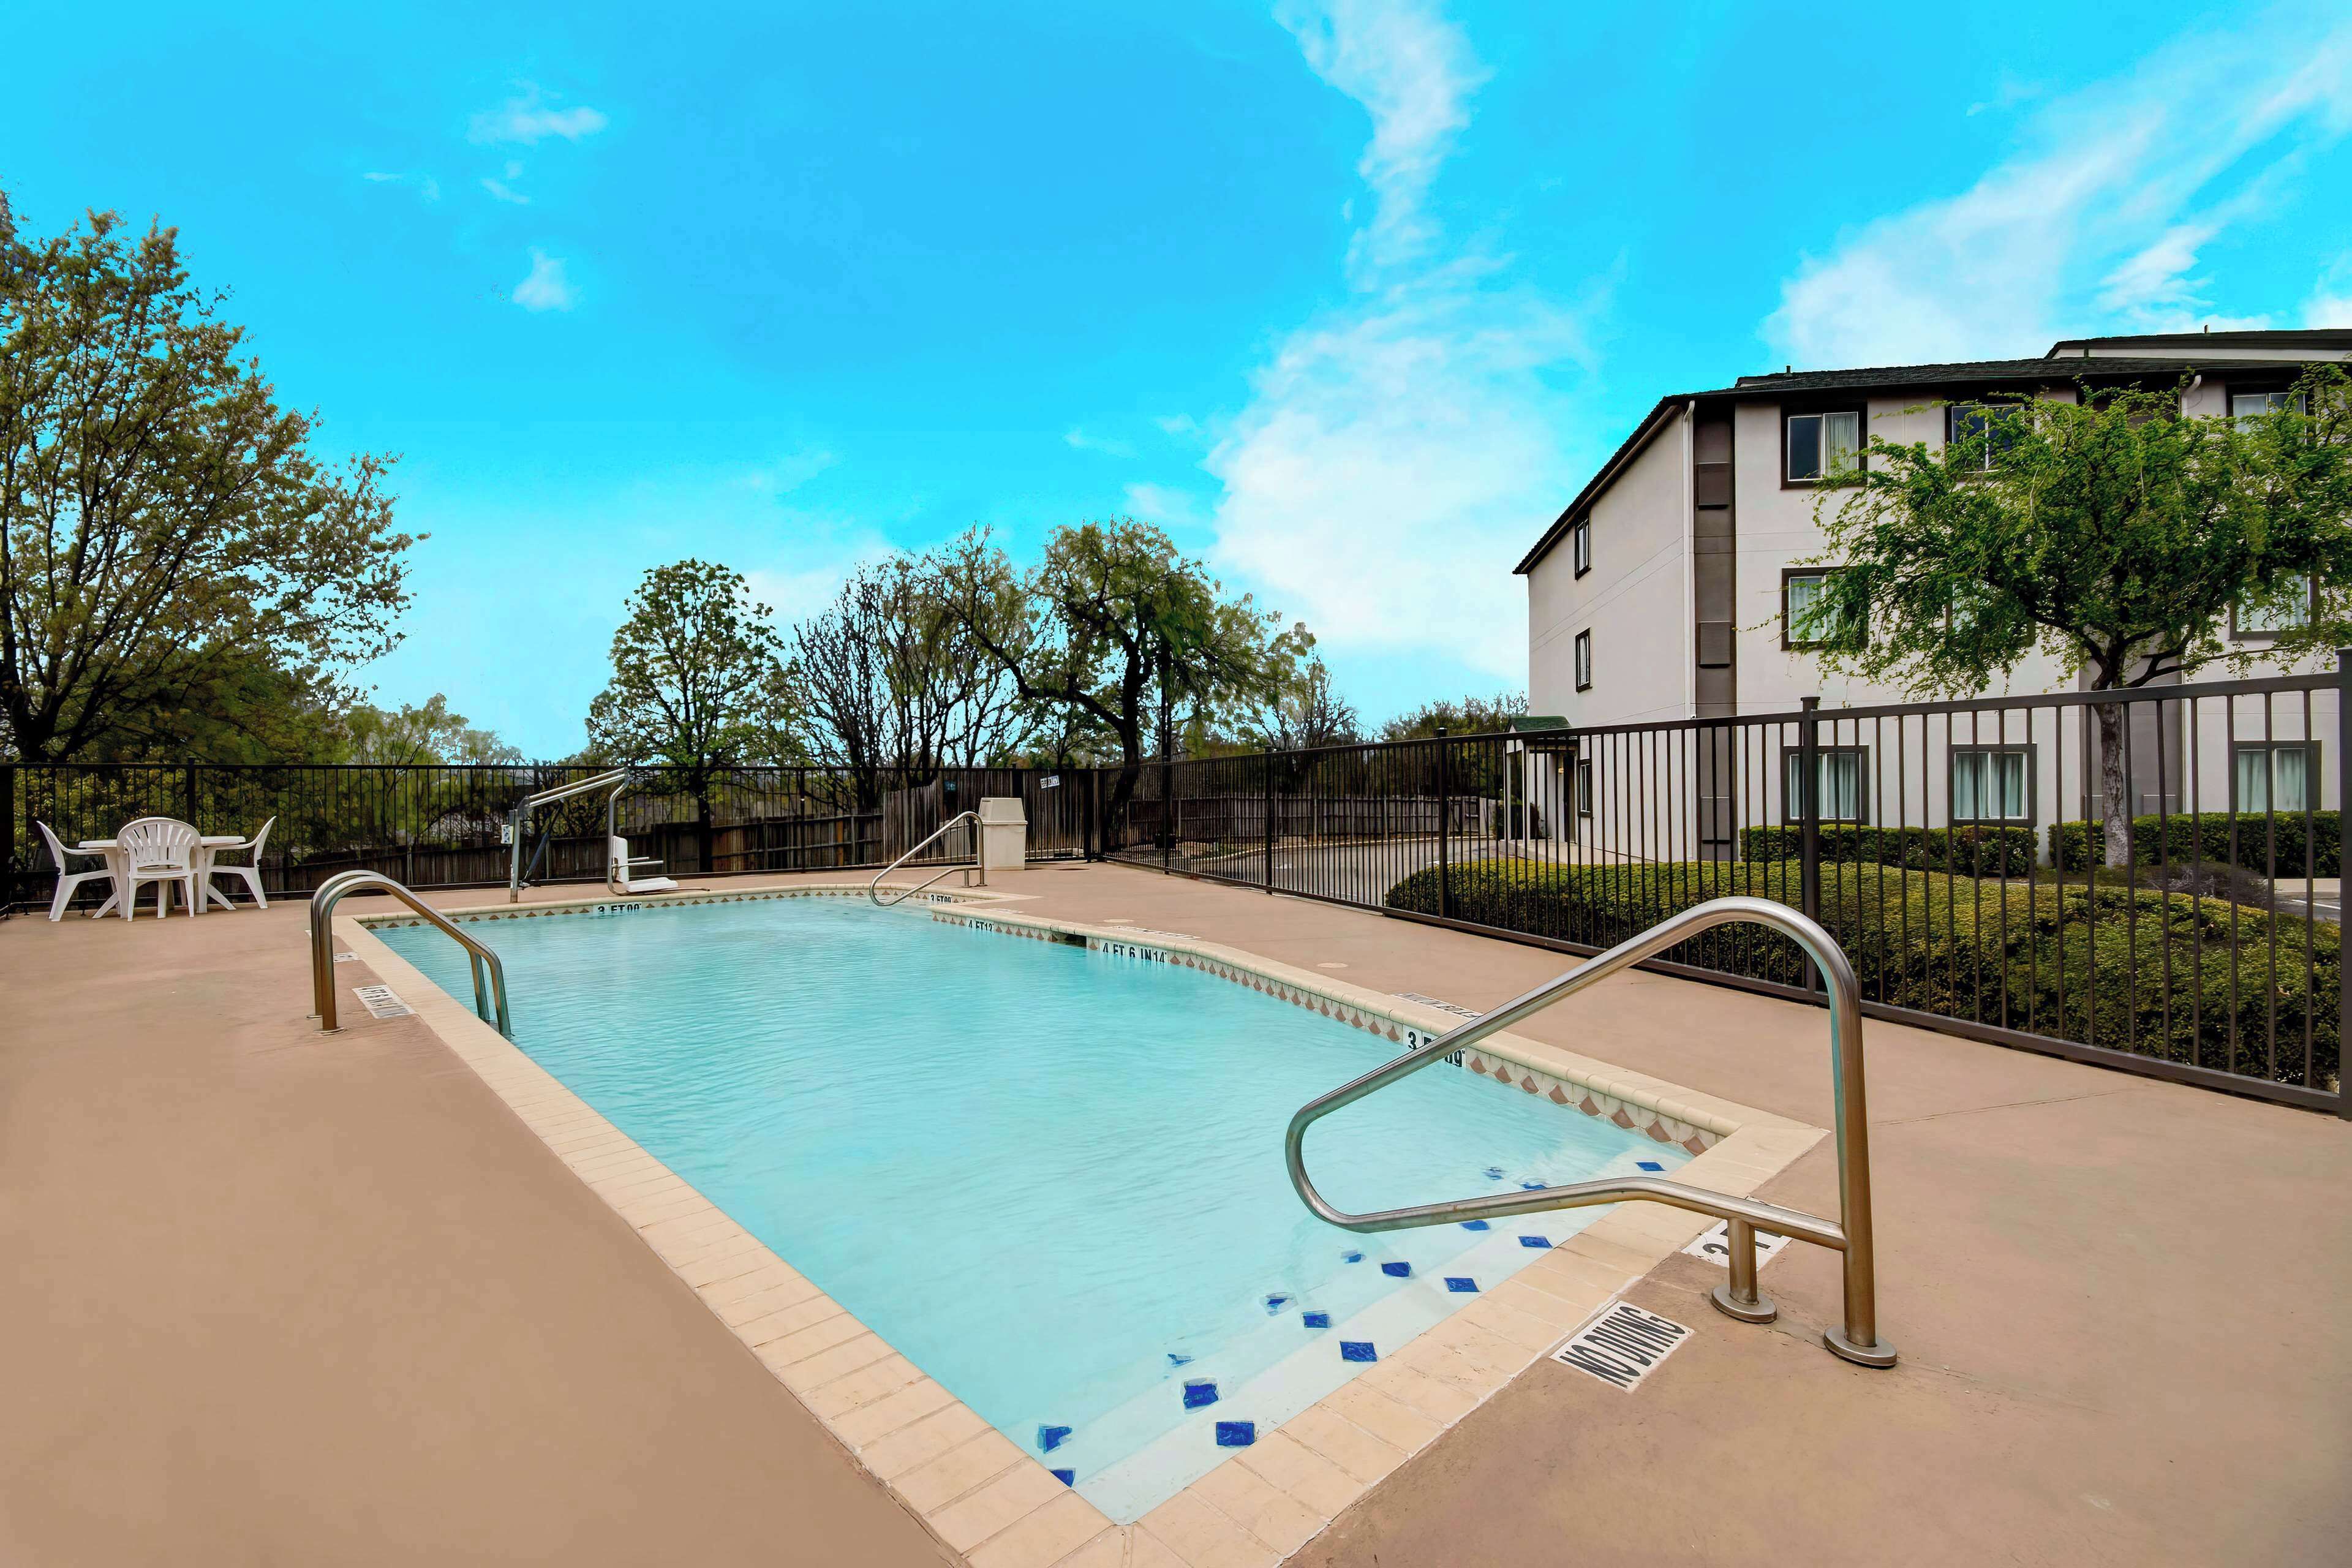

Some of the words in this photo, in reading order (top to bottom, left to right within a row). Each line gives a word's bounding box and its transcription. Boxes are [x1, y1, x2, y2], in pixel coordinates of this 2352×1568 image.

[1113, 944, 1125, 956] FT
[1129, 946, 1136, 958] 6
[1140, 948, 1152, 961] IN
[1408, 1031, 1417, 1050] 3
[1583, 1306, 1686, 1367] DIVING
[1559, 1344, 1641, 1389] NO
